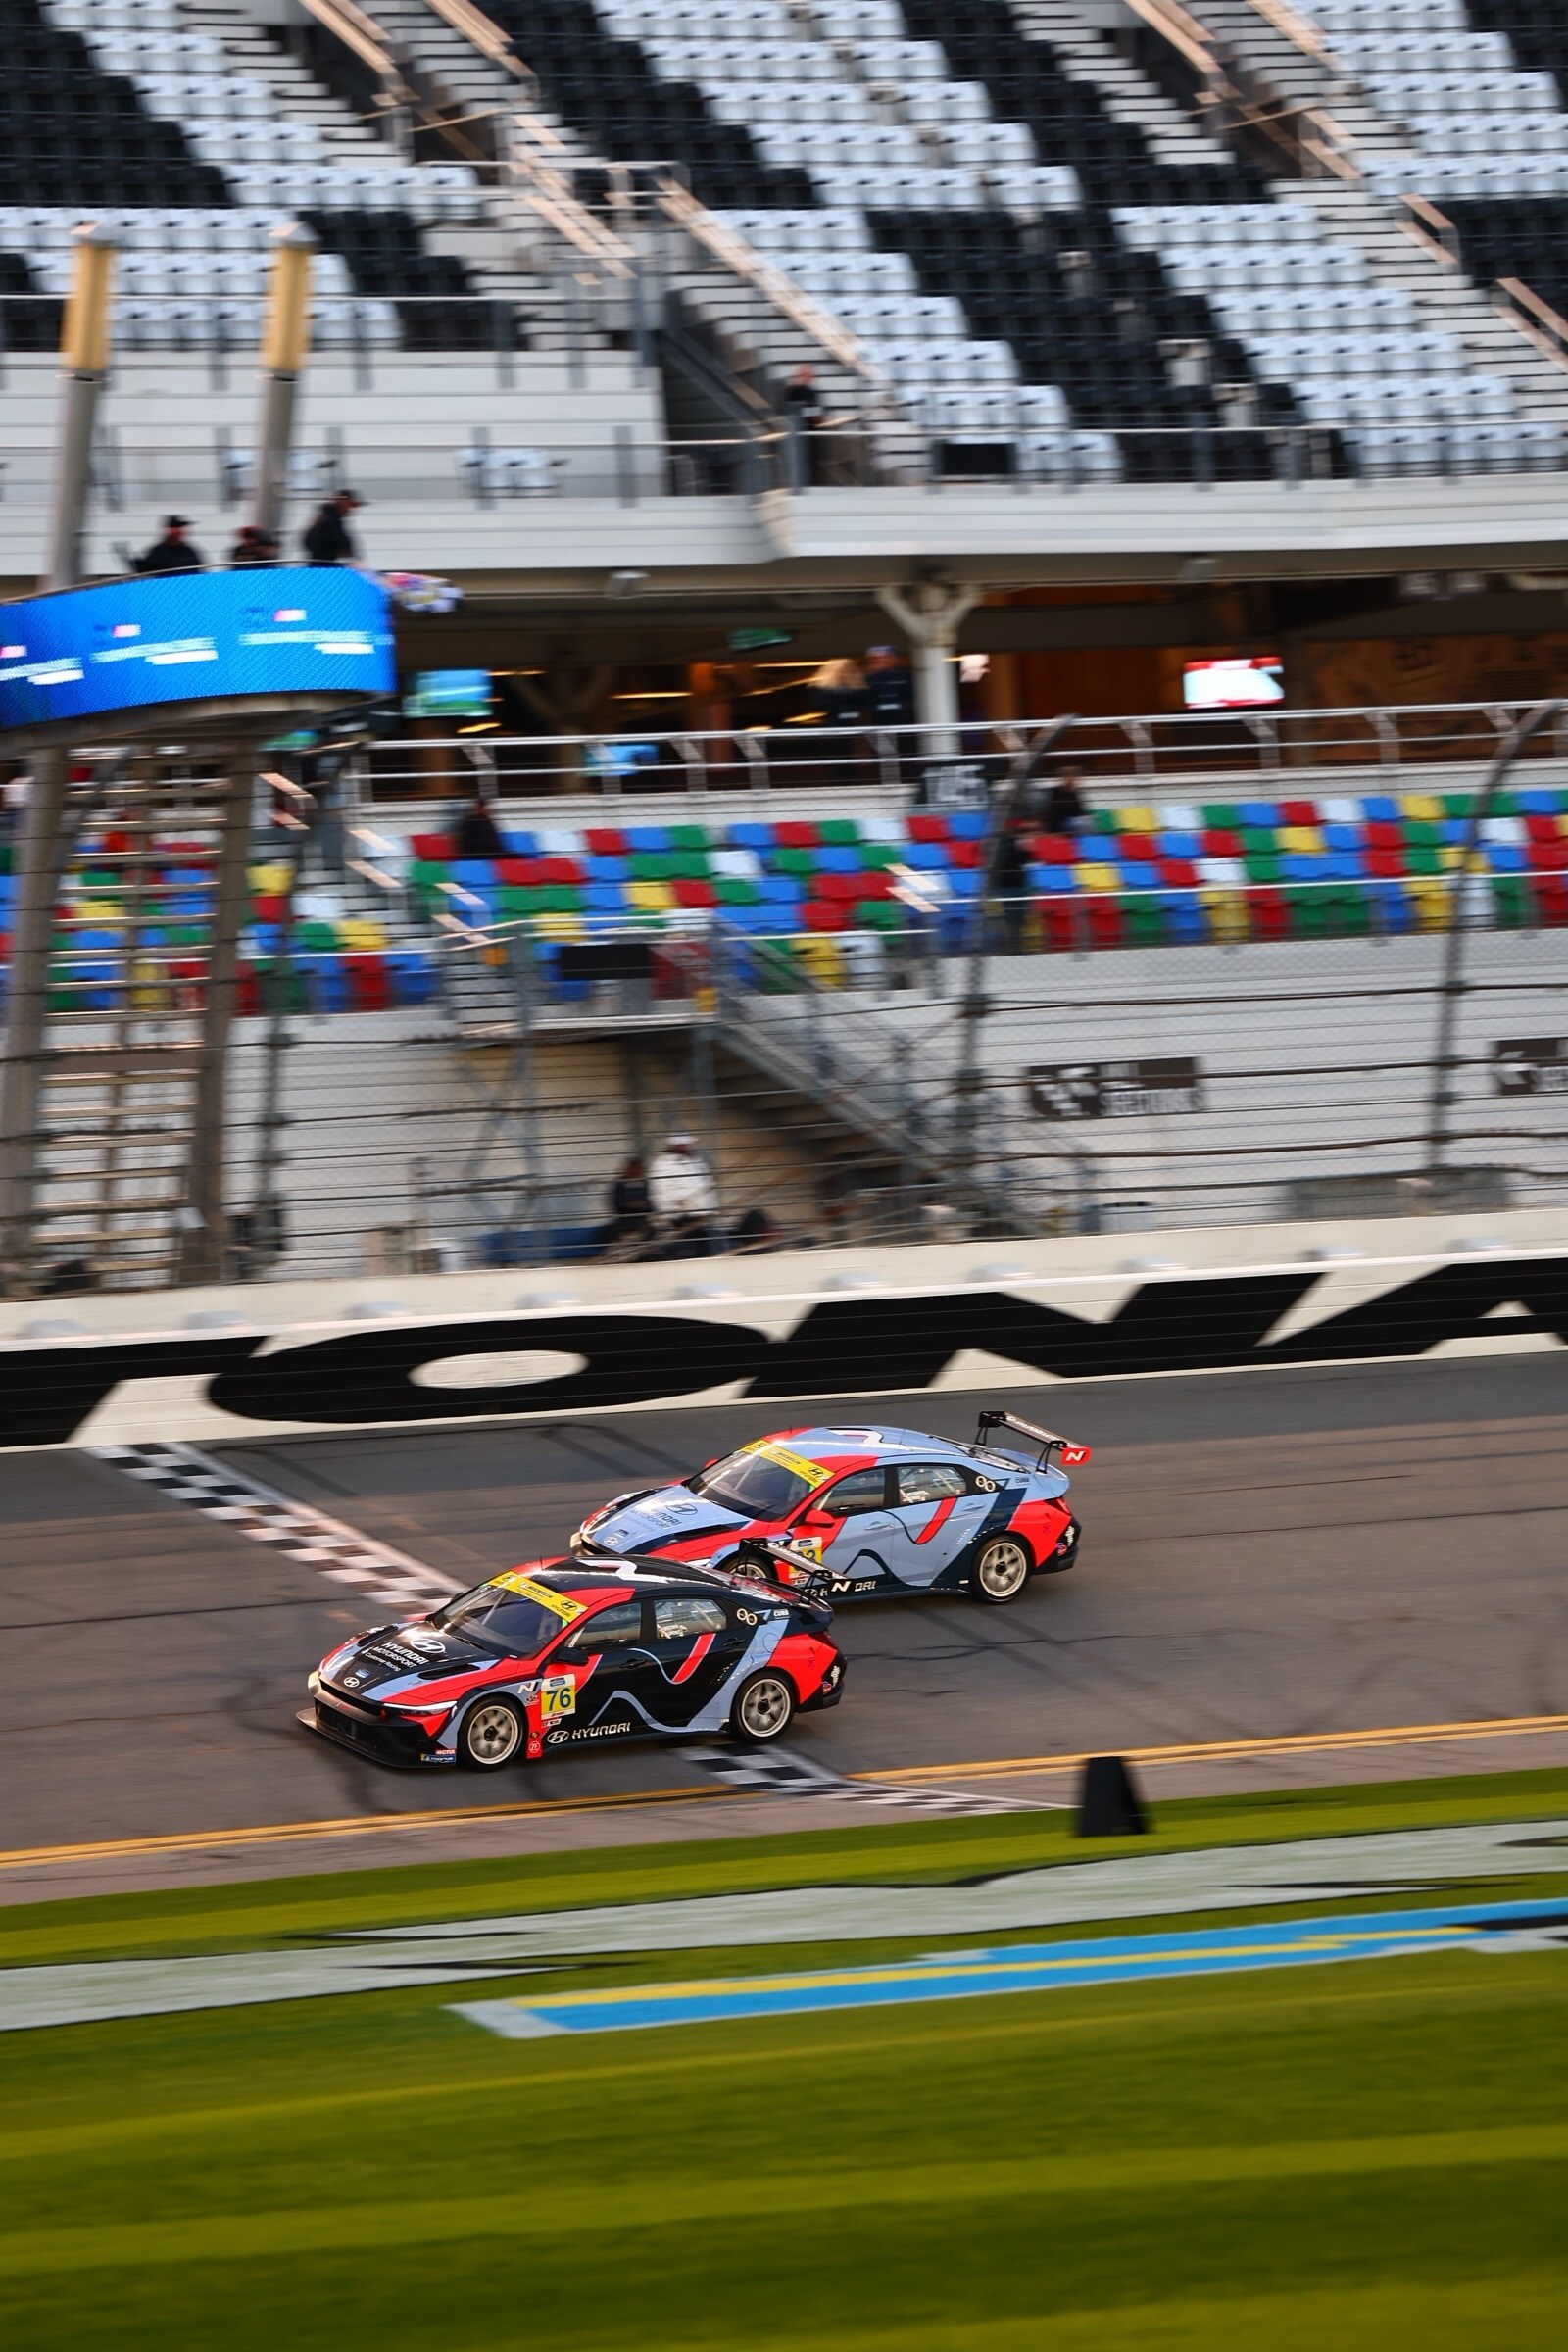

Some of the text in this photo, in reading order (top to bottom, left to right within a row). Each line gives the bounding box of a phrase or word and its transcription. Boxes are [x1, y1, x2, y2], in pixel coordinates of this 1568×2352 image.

[1065, 1451, 1085, 1461] N
[831, 1581, 851, 1592] N
[551, 1604, 571, 1618] HYUNDAI
[773, 1608, 790, 1617] CURB
[372, 1646, 418, 1668] MOTORSPORT
[381, 1642, 429, 1665] HYUNDAI
[385, 1660, 402, 1672] Racing
[546, 1687, 571, 1711] 76
[572, 1722, 631, 1740] HYUNDAI
